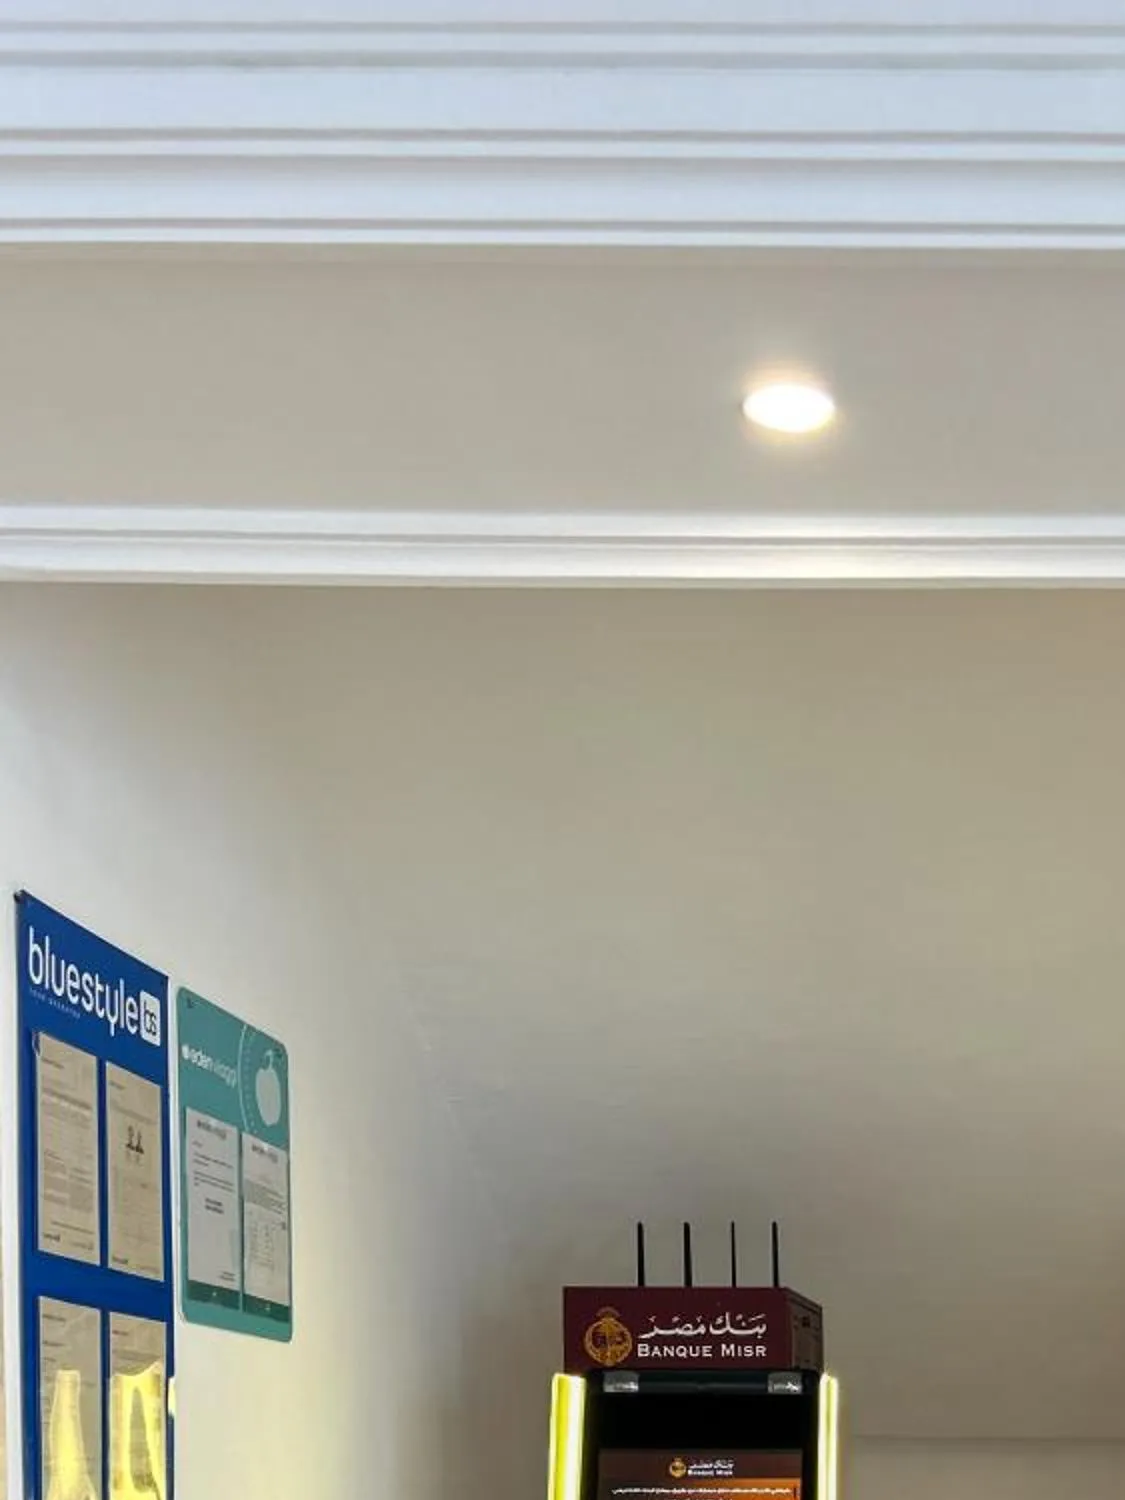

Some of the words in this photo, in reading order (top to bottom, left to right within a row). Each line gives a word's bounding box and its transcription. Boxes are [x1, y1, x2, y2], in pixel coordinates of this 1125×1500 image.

[28, 925, 139, 1037] bluestyle
[637, 1314, 707, 1340] مصر
[709, 1311, 768, 1339] بنك
[637, 1344, 713, 1358] BANQUE
[721, 1344, 768, 1358] MISR
